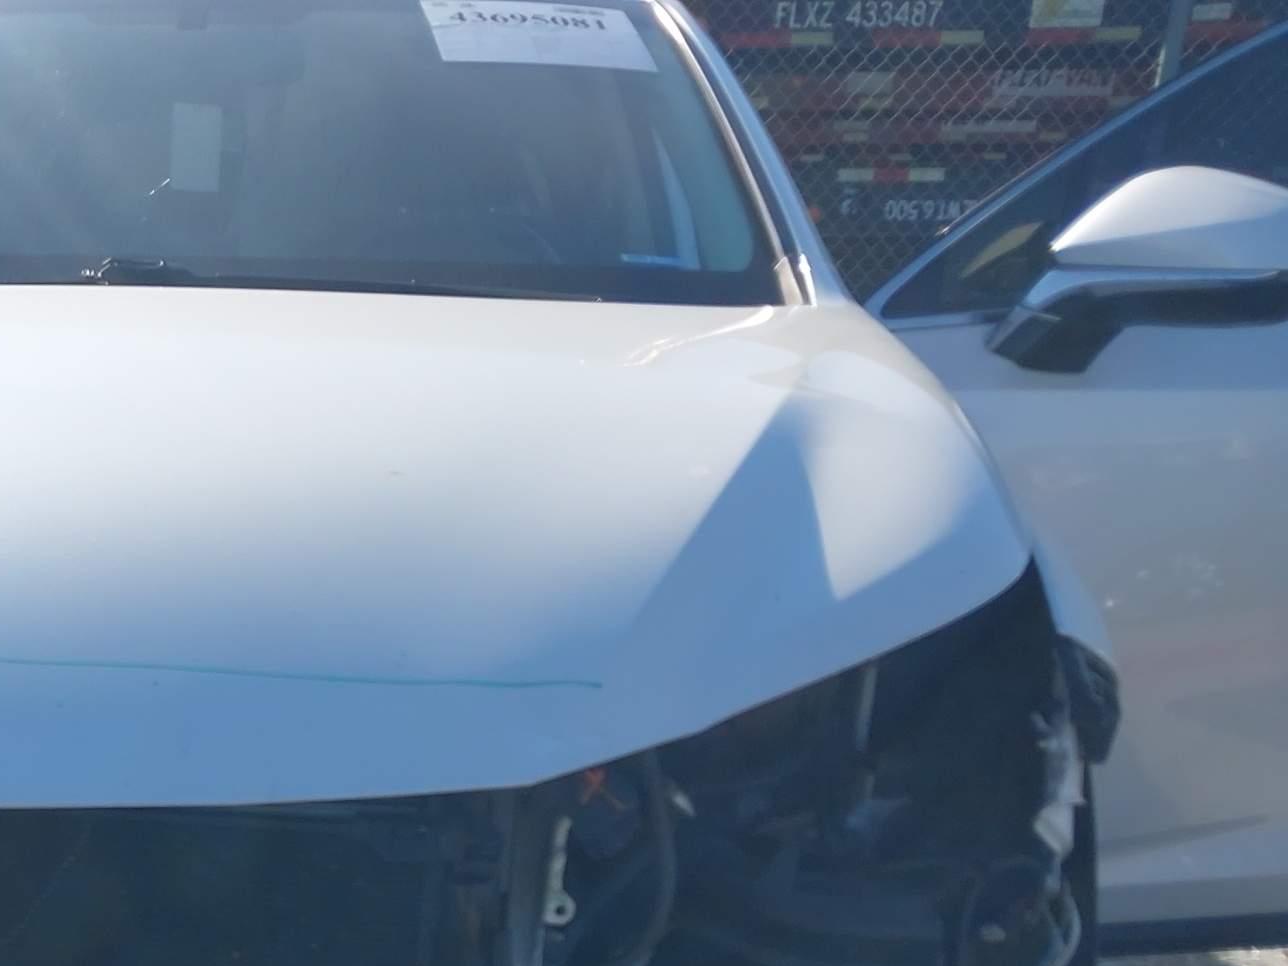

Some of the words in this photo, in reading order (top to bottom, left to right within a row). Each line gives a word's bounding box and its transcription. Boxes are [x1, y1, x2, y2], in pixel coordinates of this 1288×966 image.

[449, 11, 607, 31] 43695081
[775, 1, 834, 28] FLXZ
[845, 1, 944, 27] 433487
